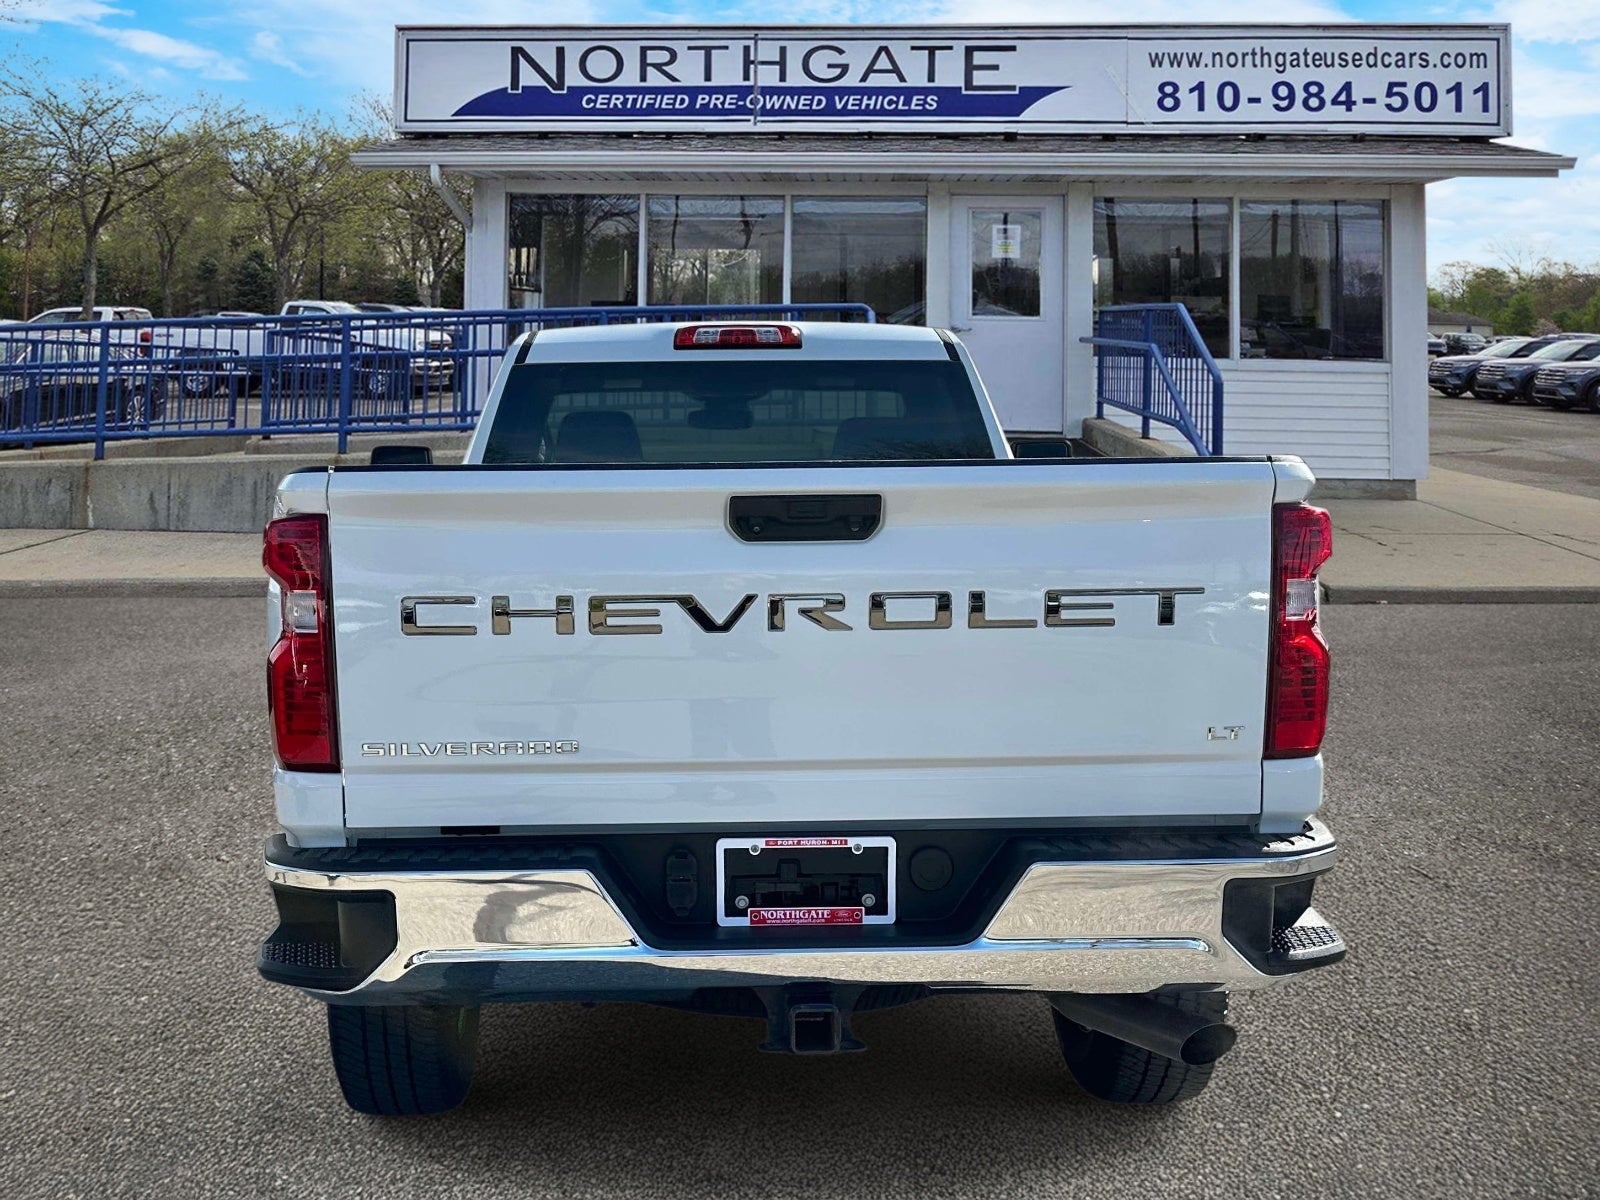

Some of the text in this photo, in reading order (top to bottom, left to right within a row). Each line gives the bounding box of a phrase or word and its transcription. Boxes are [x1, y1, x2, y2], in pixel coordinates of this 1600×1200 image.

[510, 44, 1017, 92] NORTHGATE
[1148, 47, 1488, 74] www.northgateusedcars.com
[581, 94, 939, 111] CERTIFIED PRE-OWNED VEHICLES
[1156, 80, 1491, 113] 810-984-5011
[400, 587, 1205, 636] CHEVROLET
[1207, 725, 1246, 741] LT
[361, 739, 580, 757] SILVERADO
[760, 909, 832, 920] NORTHGATE
